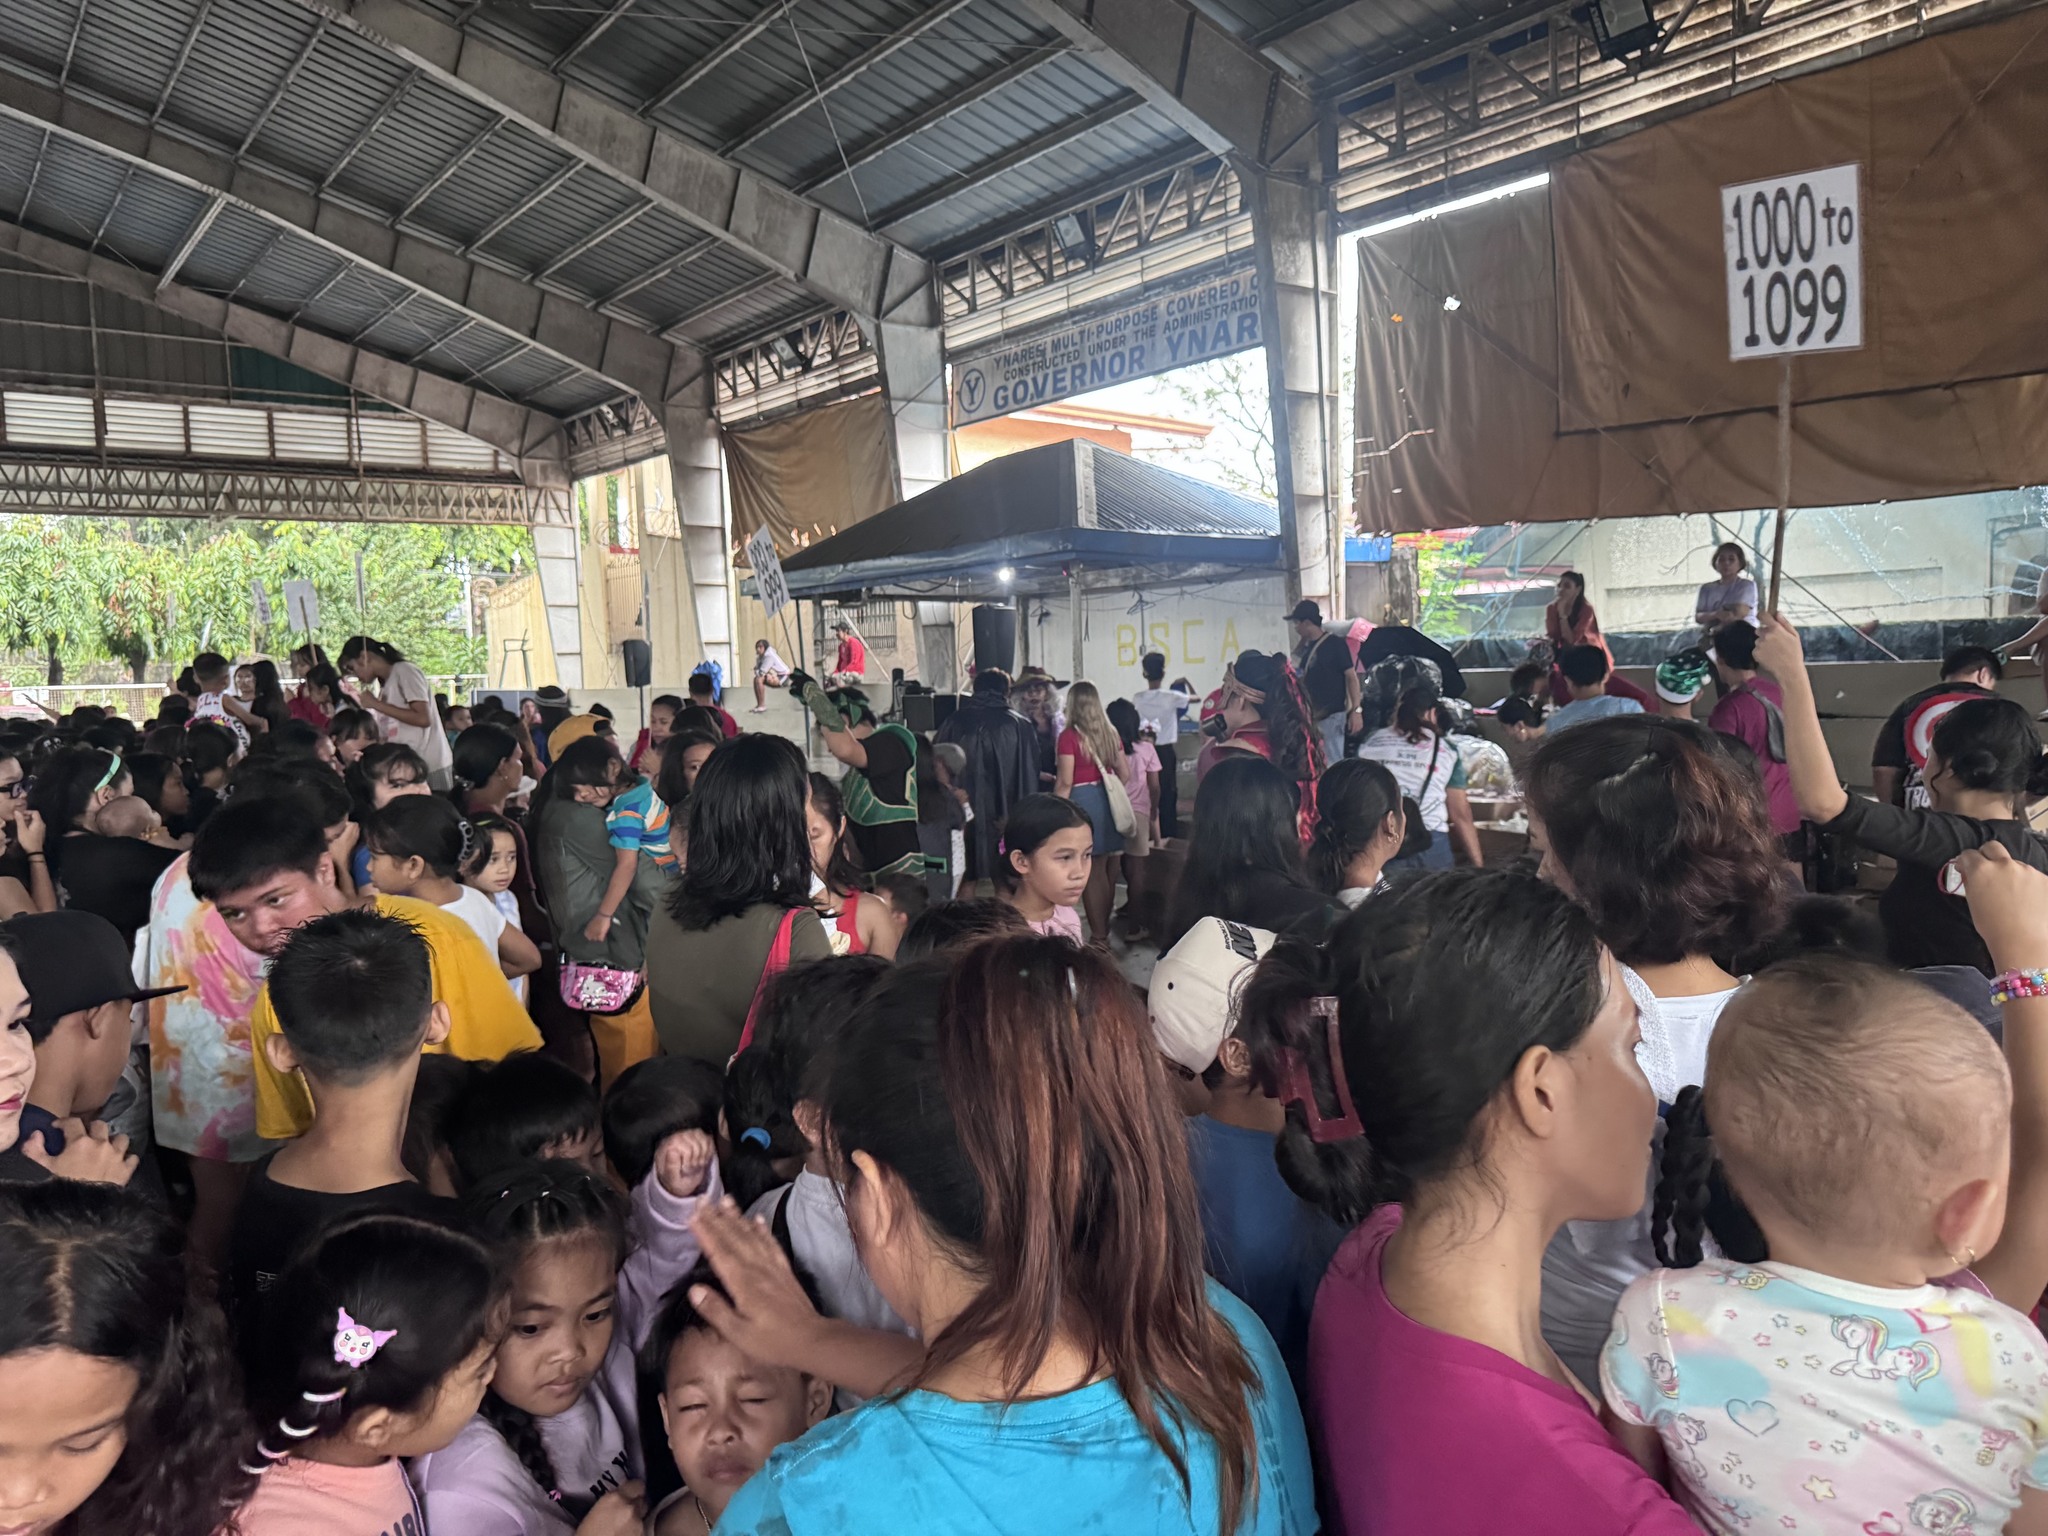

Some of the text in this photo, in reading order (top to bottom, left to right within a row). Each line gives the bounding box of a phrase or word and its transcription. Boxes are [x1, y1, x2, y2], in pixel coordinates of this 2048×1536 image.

[1733, 183, 1853, 270] 1000 to
[1051, 305, 1158, 352] MULTI-PURPOSE
[1166, 280, 1240, 317] COVERED
[1743, 264, 1847, 347] 1099
[993, 311, 1259, 411] GOVERNOR YNAR
[1004, 351, 1080, 381] CONSTRUCTED
[1088, 335, 1126, 357] UNDER
[1134, 325, 1156, 342] THE
[1116, 616, 1241, 667] BSCA
